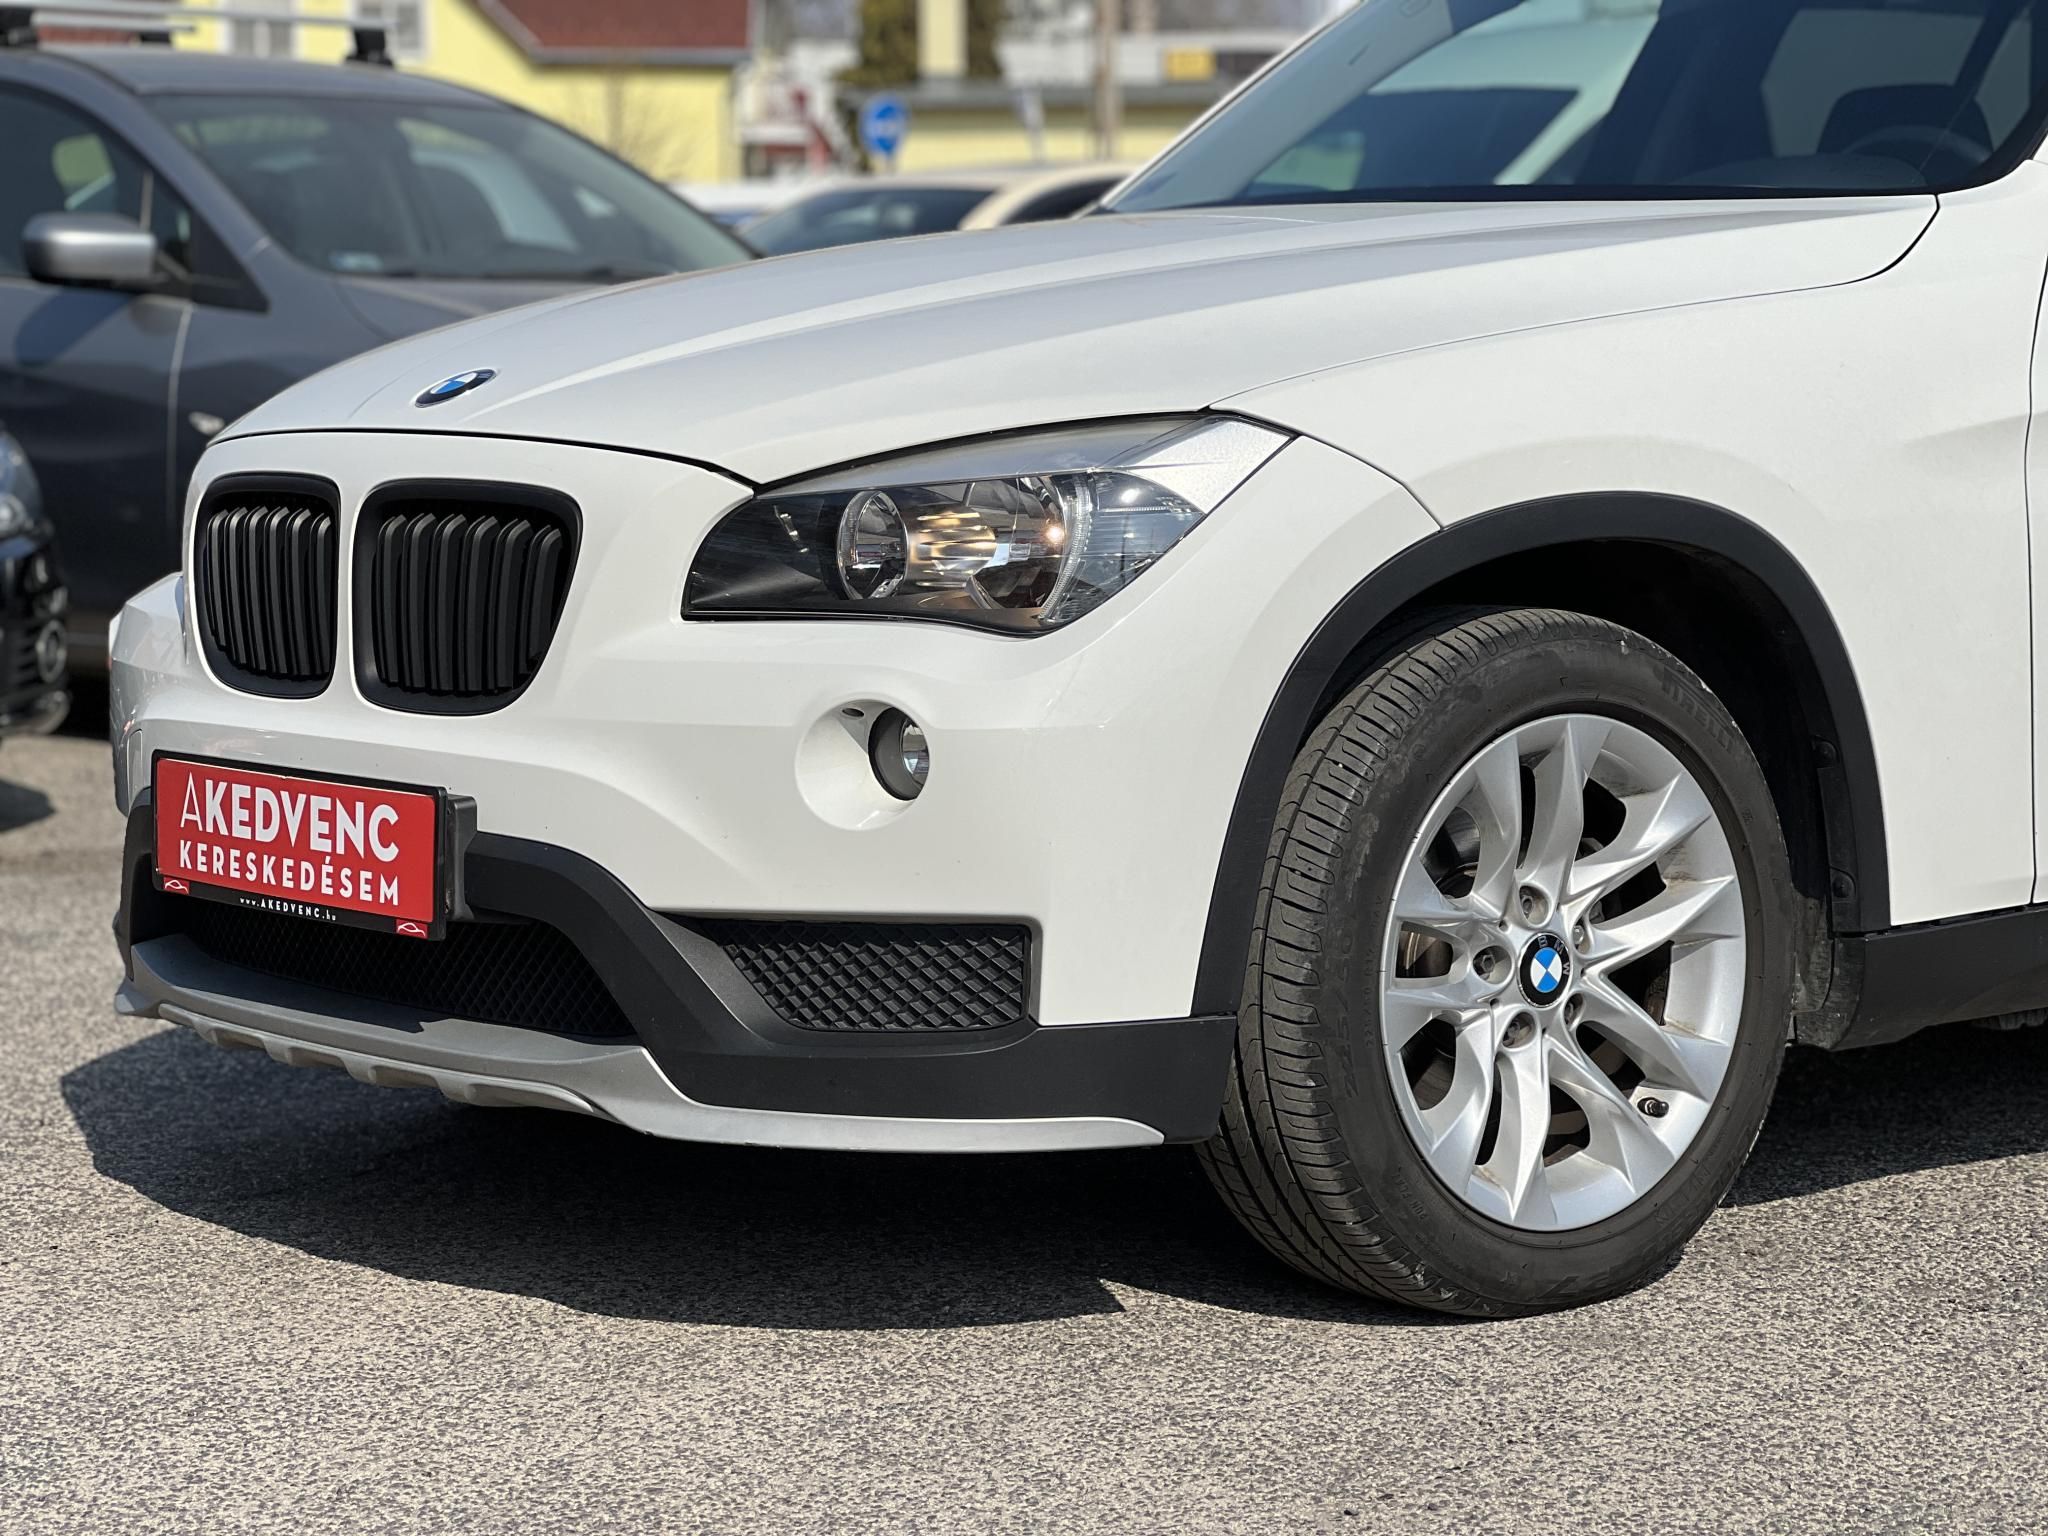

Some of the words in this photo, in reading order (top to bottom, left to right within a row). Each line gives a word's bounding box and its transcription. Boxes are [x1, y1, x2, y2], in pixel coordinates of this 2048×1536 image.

[181, 772, 399, 862] AKEDVENC
[180, 840, 399, 906] KERESKEDÉSEM
[240, 897, 336, 921] www.AKEDVENC.hu
[1538, 936, 1570, 975] BMW
